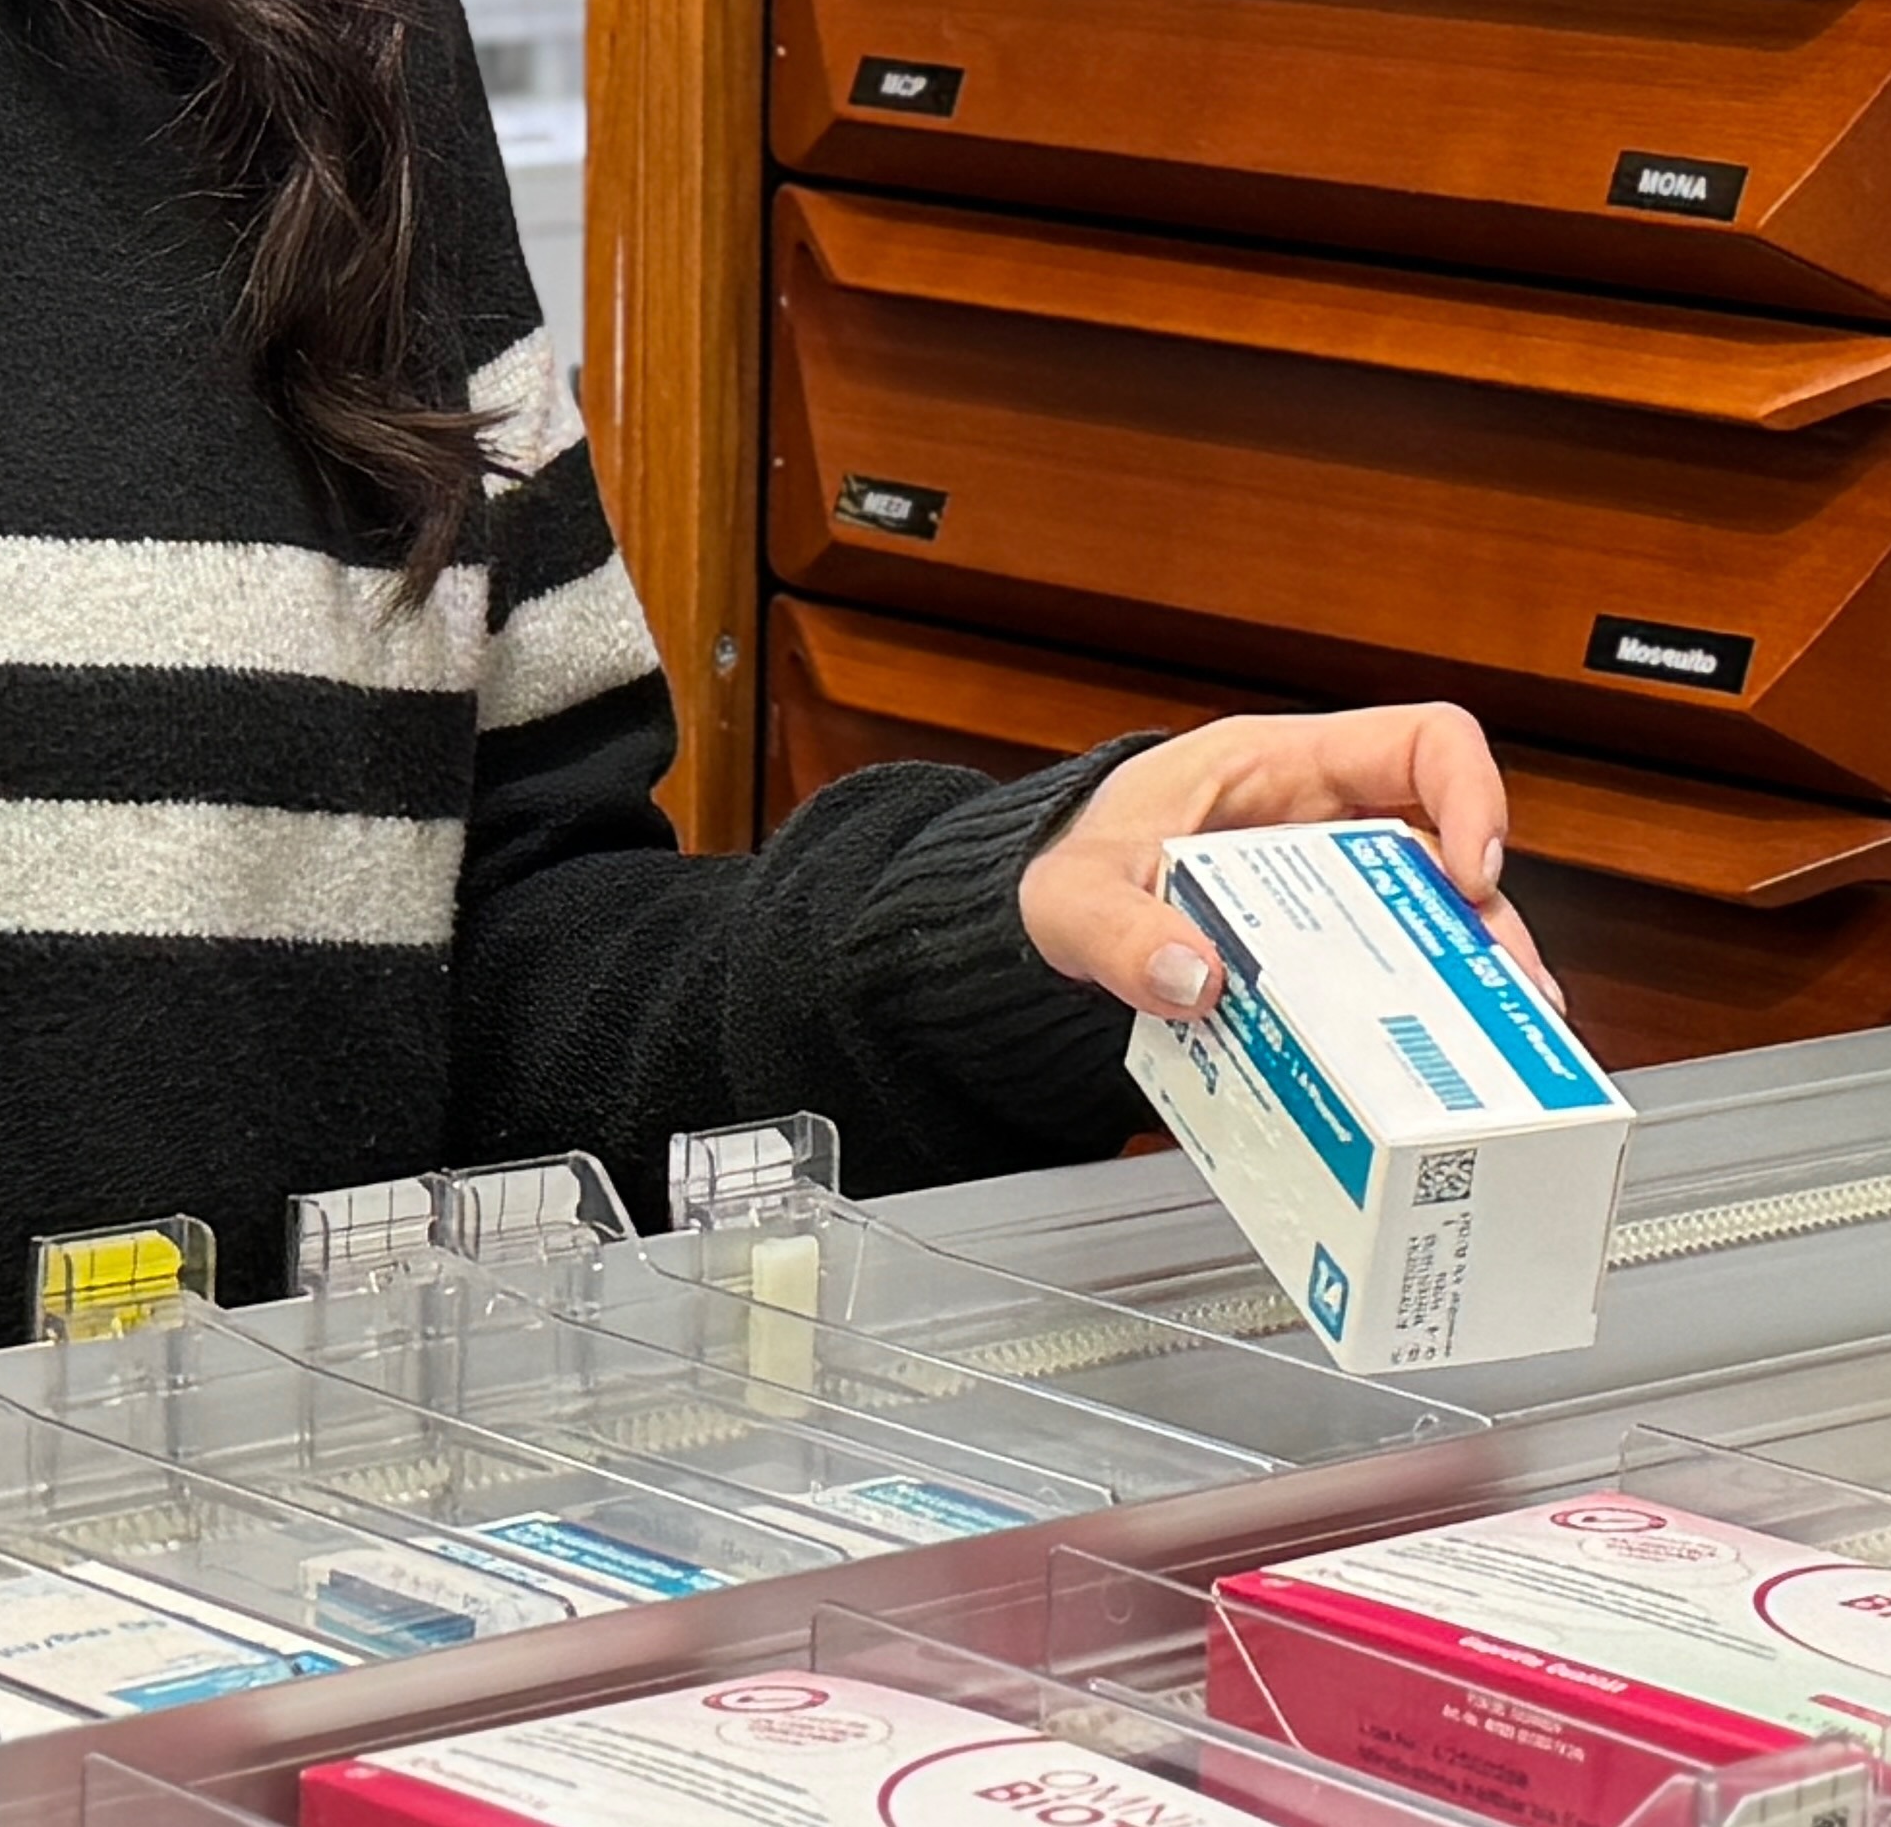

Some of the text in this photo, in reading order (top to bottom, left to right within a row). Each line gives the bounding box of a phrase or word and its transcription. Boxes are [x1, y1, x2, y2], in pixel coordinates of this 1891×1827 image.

[881, 73, 928, 97] MCP
[1638, 168, 1707, 201] MONA
[1616, 636, 1718, 674] Mosquito
